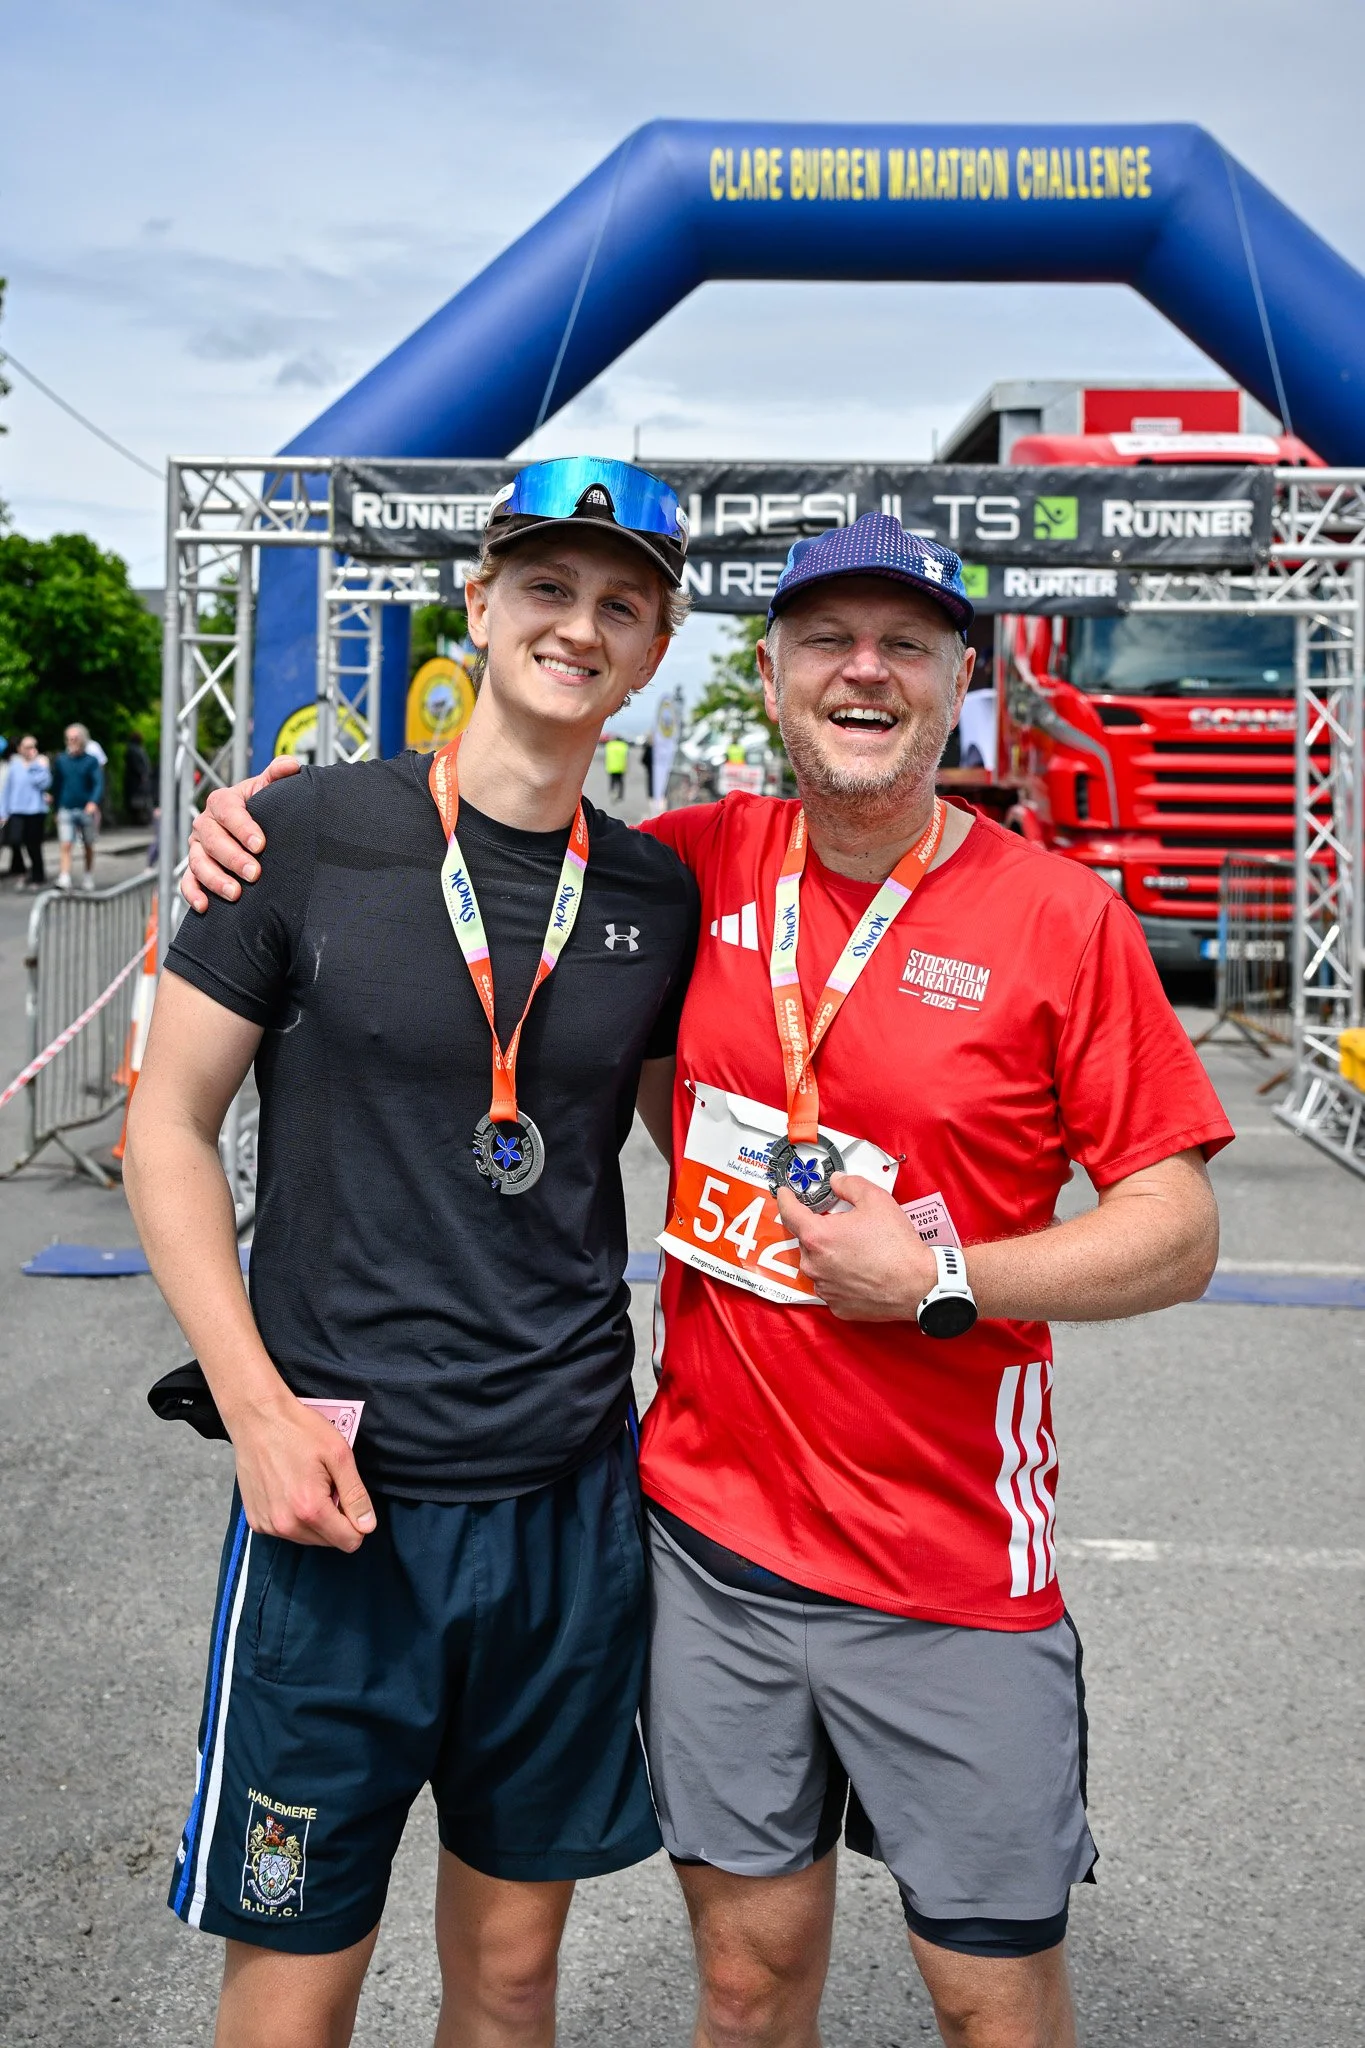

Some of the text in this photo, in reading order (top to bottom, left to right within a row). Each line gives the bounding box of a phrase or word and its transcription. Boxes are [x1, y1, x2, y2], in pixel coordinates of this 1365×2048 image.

[709, 146, 1152, 201] CLARE BURREN MARATHON CHALLENGE
[352, 492, 488, 531] RUNNER
[1102, 499, 1254, 538] RUNNER
[1004, 568, 1118, 598] RUNNER
[449, 868, 476, 923] MONKS
[553, 883, 576, 932] MONKS
[779, 903, 797, 951] MONKS
[852, 913, 890, 959] MONKS
[902, 964, 986, 1002] MARATHON
[907, 949, 991, 986] STOCKHOLM
[785, 998, 801, 1040] CLARE
[921, 990, 957, 1011] 2025
[740, 1146, 769, 1165] CLARE
[692, 1175, 801, 1280] 542
[917, 1214, 939, 1227] 2026
[690, 1254, 716, 1273] Emergency
[714, 1266, 736, 1280] Contact
[735, 1274, 760, 1290] Number:
[247, 1787, 318, 1820] HASLEMERE
[242, 1898, 298, 1918] R.U.F.C.
